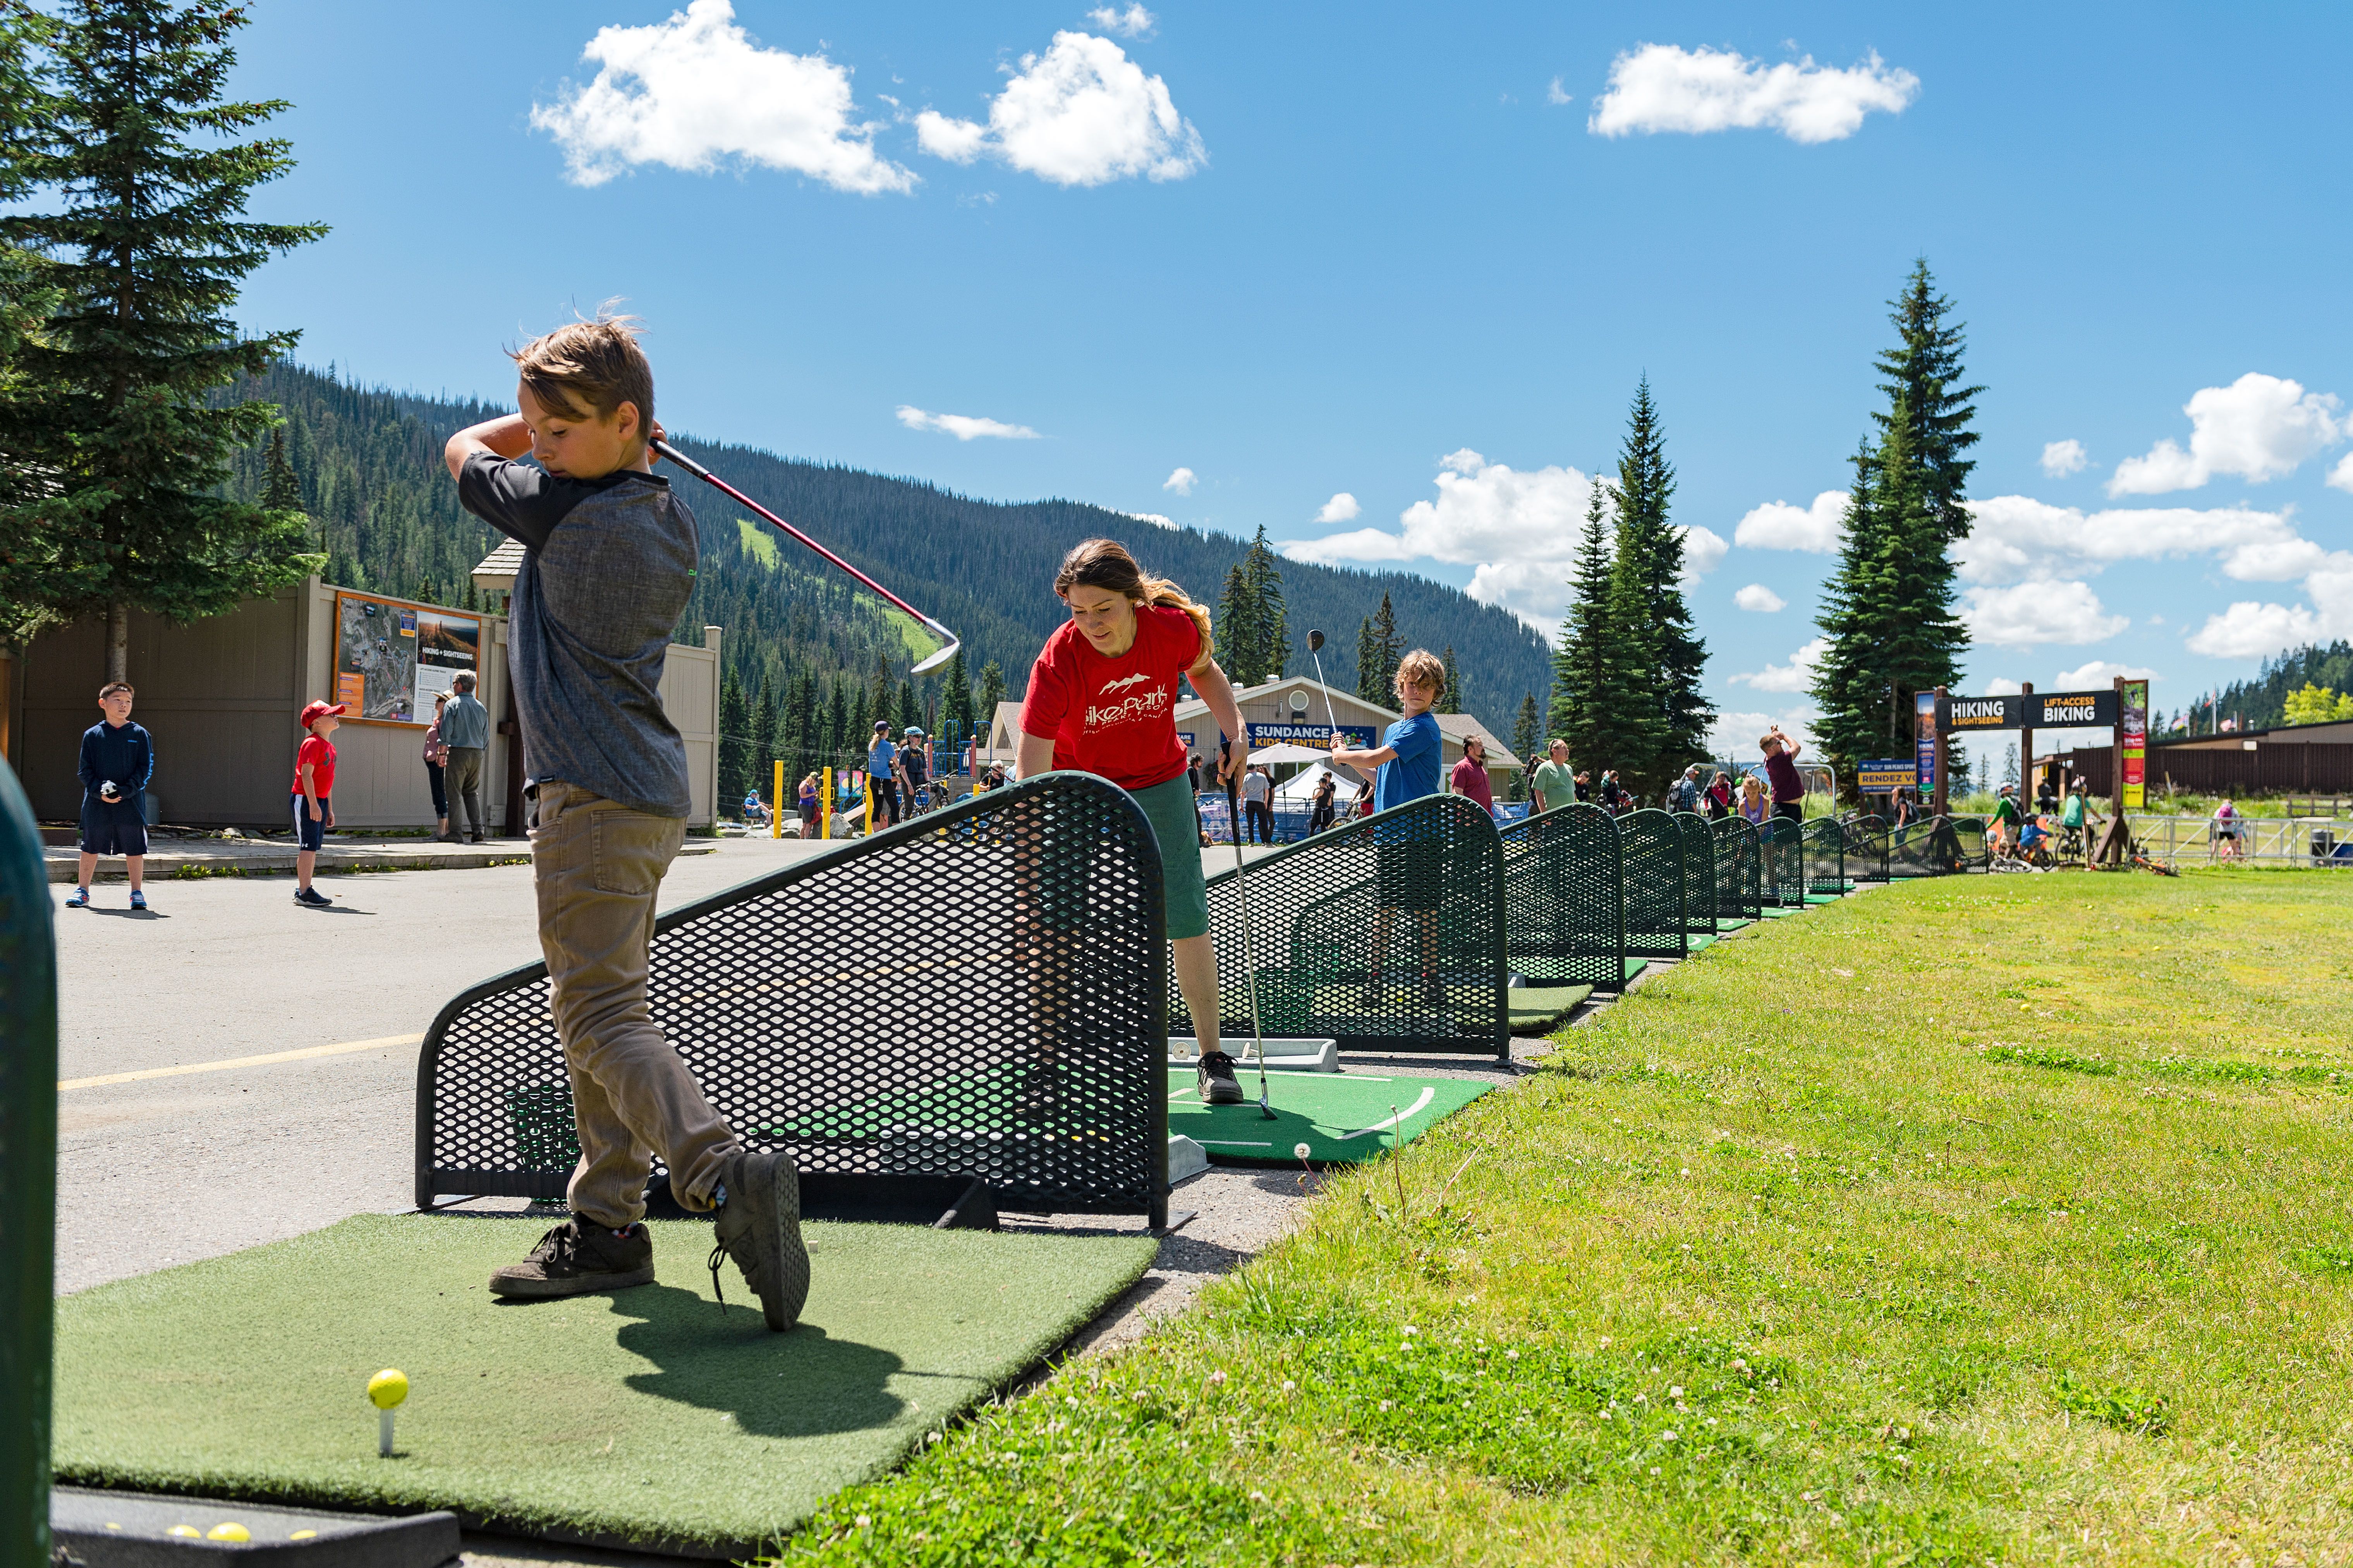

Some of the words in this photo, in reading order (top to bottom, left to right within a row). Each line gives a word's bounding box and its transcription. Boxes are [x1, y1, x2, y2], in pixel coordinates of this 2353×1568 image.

[422, 647, 439, 655] HIKING
[443, 650, 472, 660] SIGHTSEEING
[2044, 696, 2095, 707] LIFT-ACCESS
[1951, 700, 2004, 718] HIKING
[2044, 705, 2095, 722] BIKING
[1958, 716, 2003, 726] SIGHTSEEING
[1255, 726, 1329, 738] SUNDANCE
